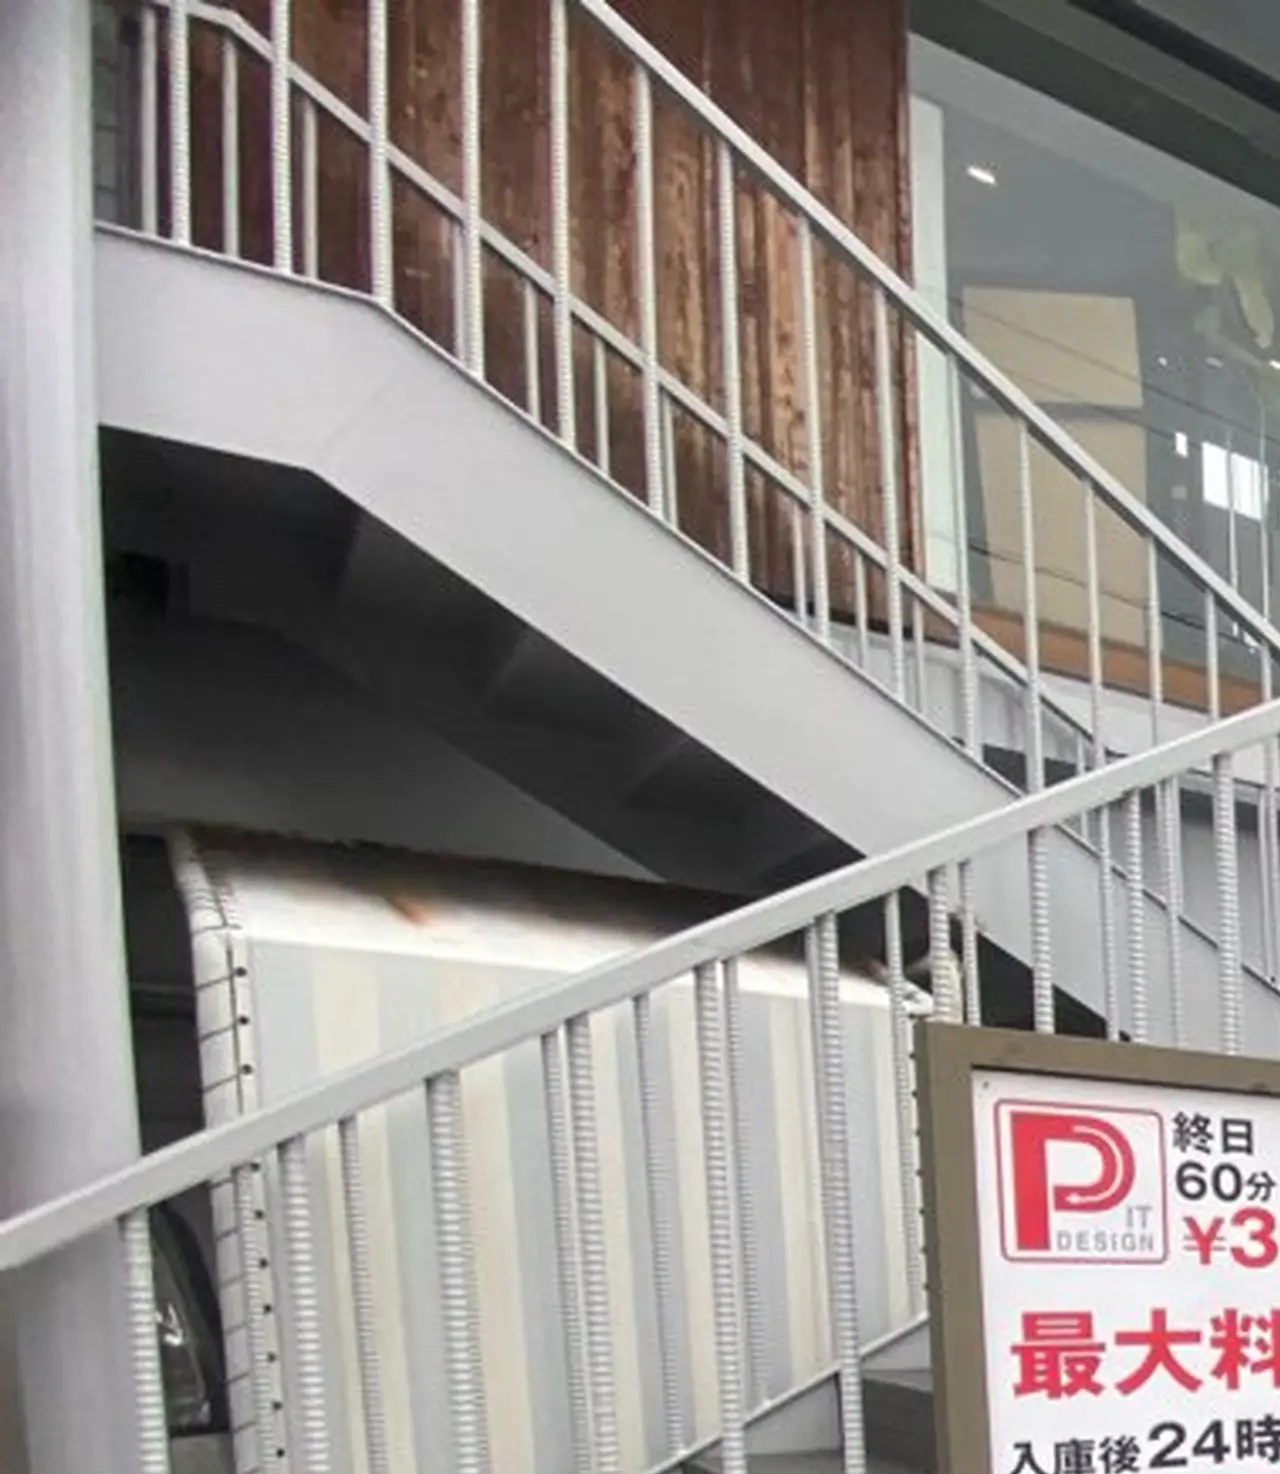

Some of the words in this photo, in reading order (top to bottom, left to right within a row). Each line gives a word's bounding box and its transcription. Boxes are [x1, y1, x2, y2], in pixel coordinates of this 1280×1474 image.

[1173, 1111, 1253, 1155] 終日
[1175, 1162, 1276, 1202] 60分
[1056, 1231, 1155, 1252] DESIGN
